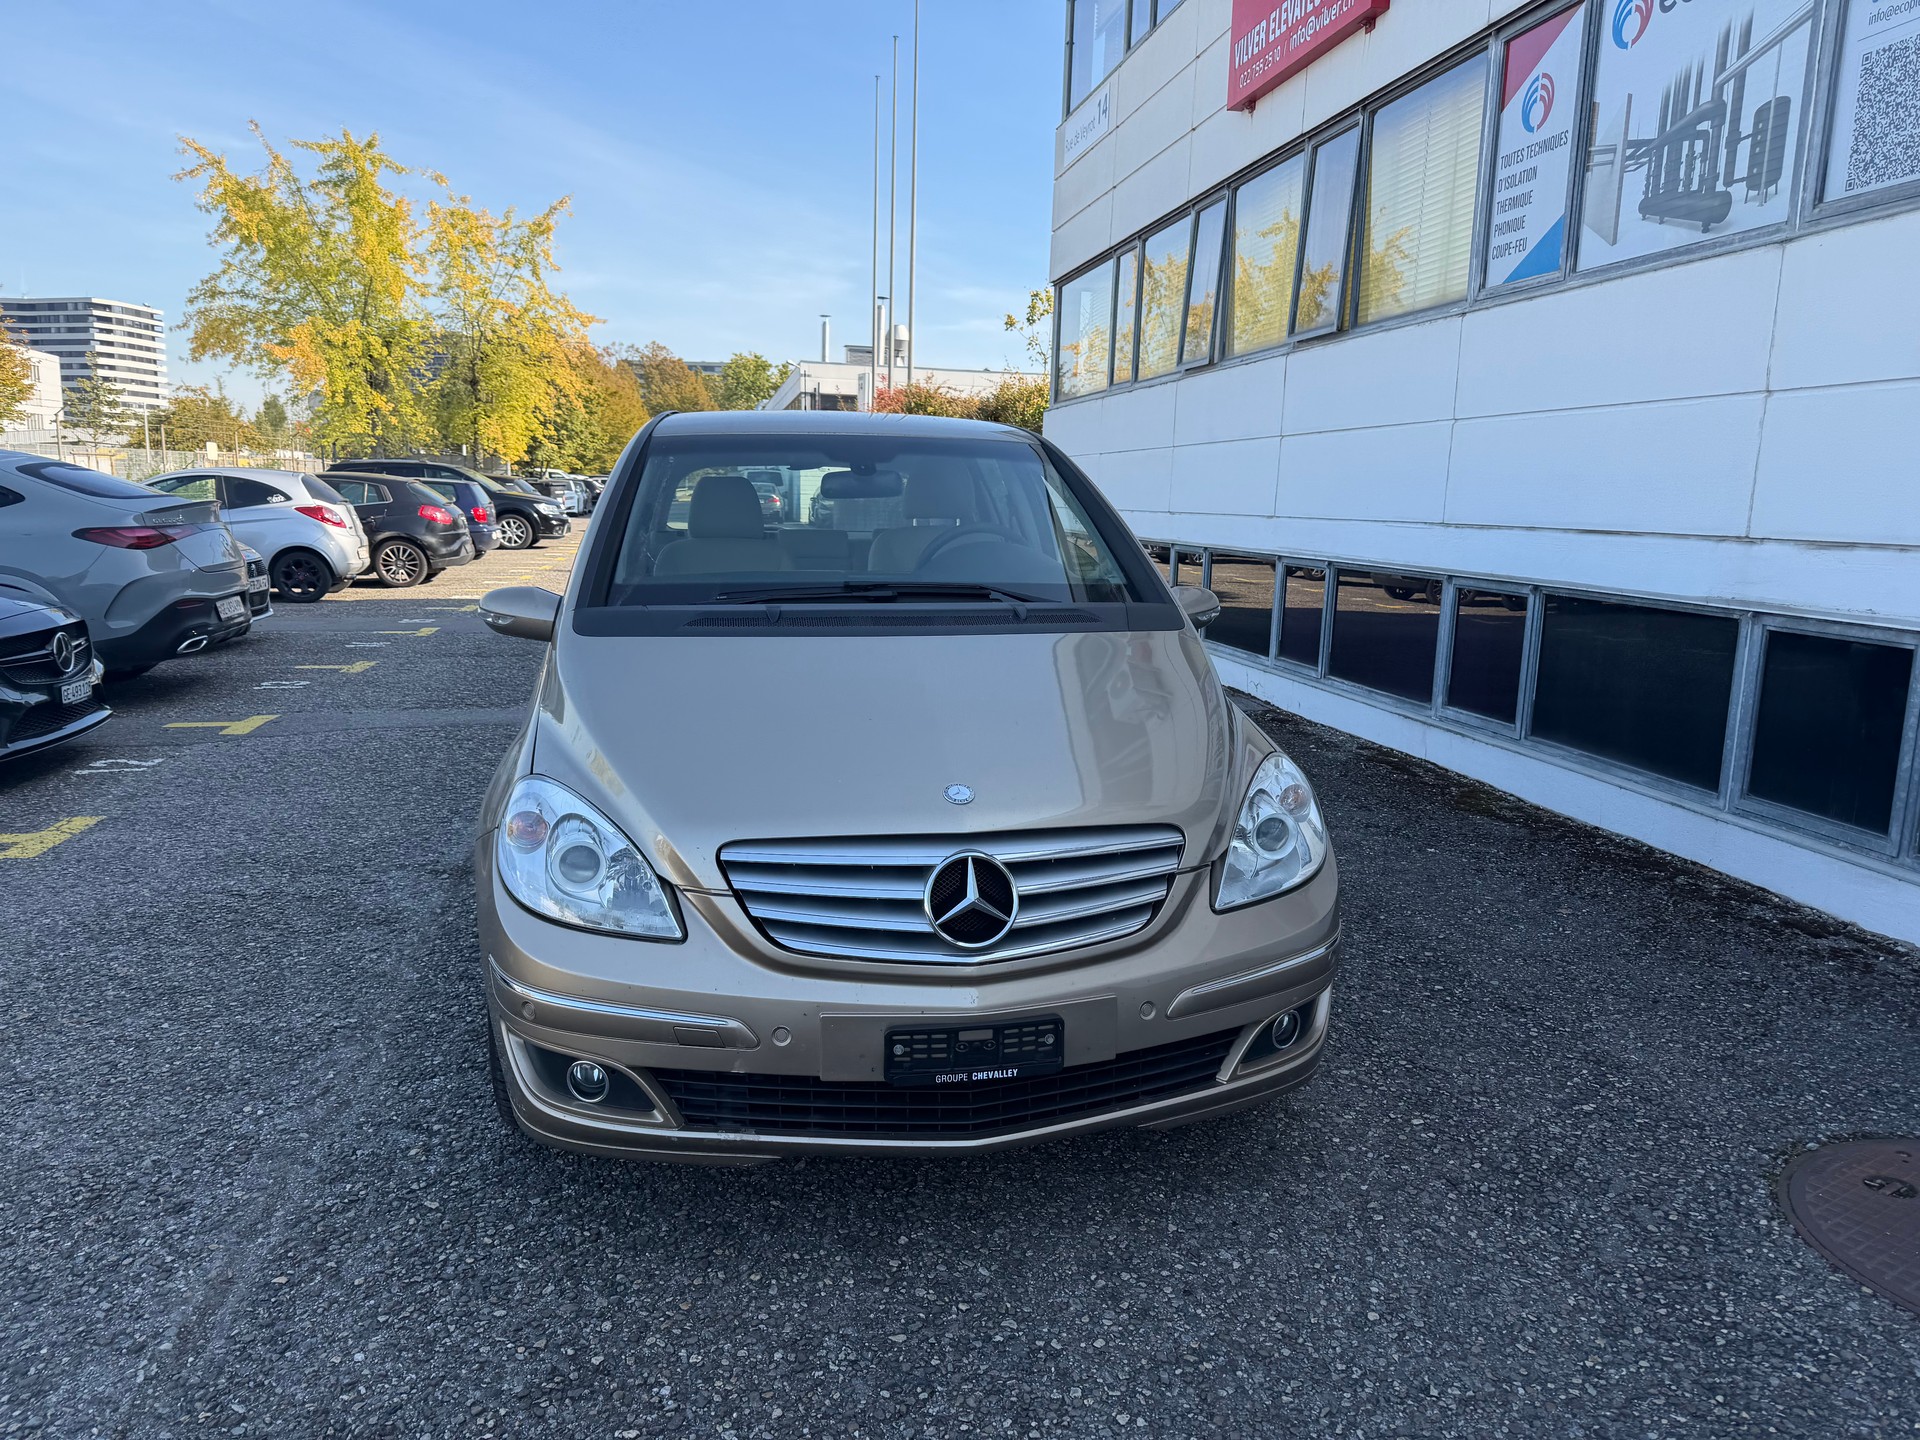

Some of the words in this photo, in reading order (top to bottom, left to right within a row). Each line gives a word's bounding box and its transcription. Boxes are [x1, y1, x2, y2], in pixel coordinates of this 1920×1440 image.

[1235, 19, 1266, 69] VILVER
[1239, 68, 1251, 88] 022
[1252, 58, 1264, 80] 755
[1264, 51, 1273, 70] 25
[1097, 92, 1108, 125] 14
[1500, 147, 1525, 170] TOUTES
[1525, 129, 1569, 160] TECHNIQUES
[1498, 165, 1538, 193] D'ISOLATION
[1496, 189, 1534, 216] THERMIQUE
[1493, 214, 1527, 239] PHONIQUE
[1491, 237, 1528, 261] COUPE-FEU
[935, 1072, 969, 1083] GROUPE
[971, 1068, 1019, 1081] CHEVALLEY
